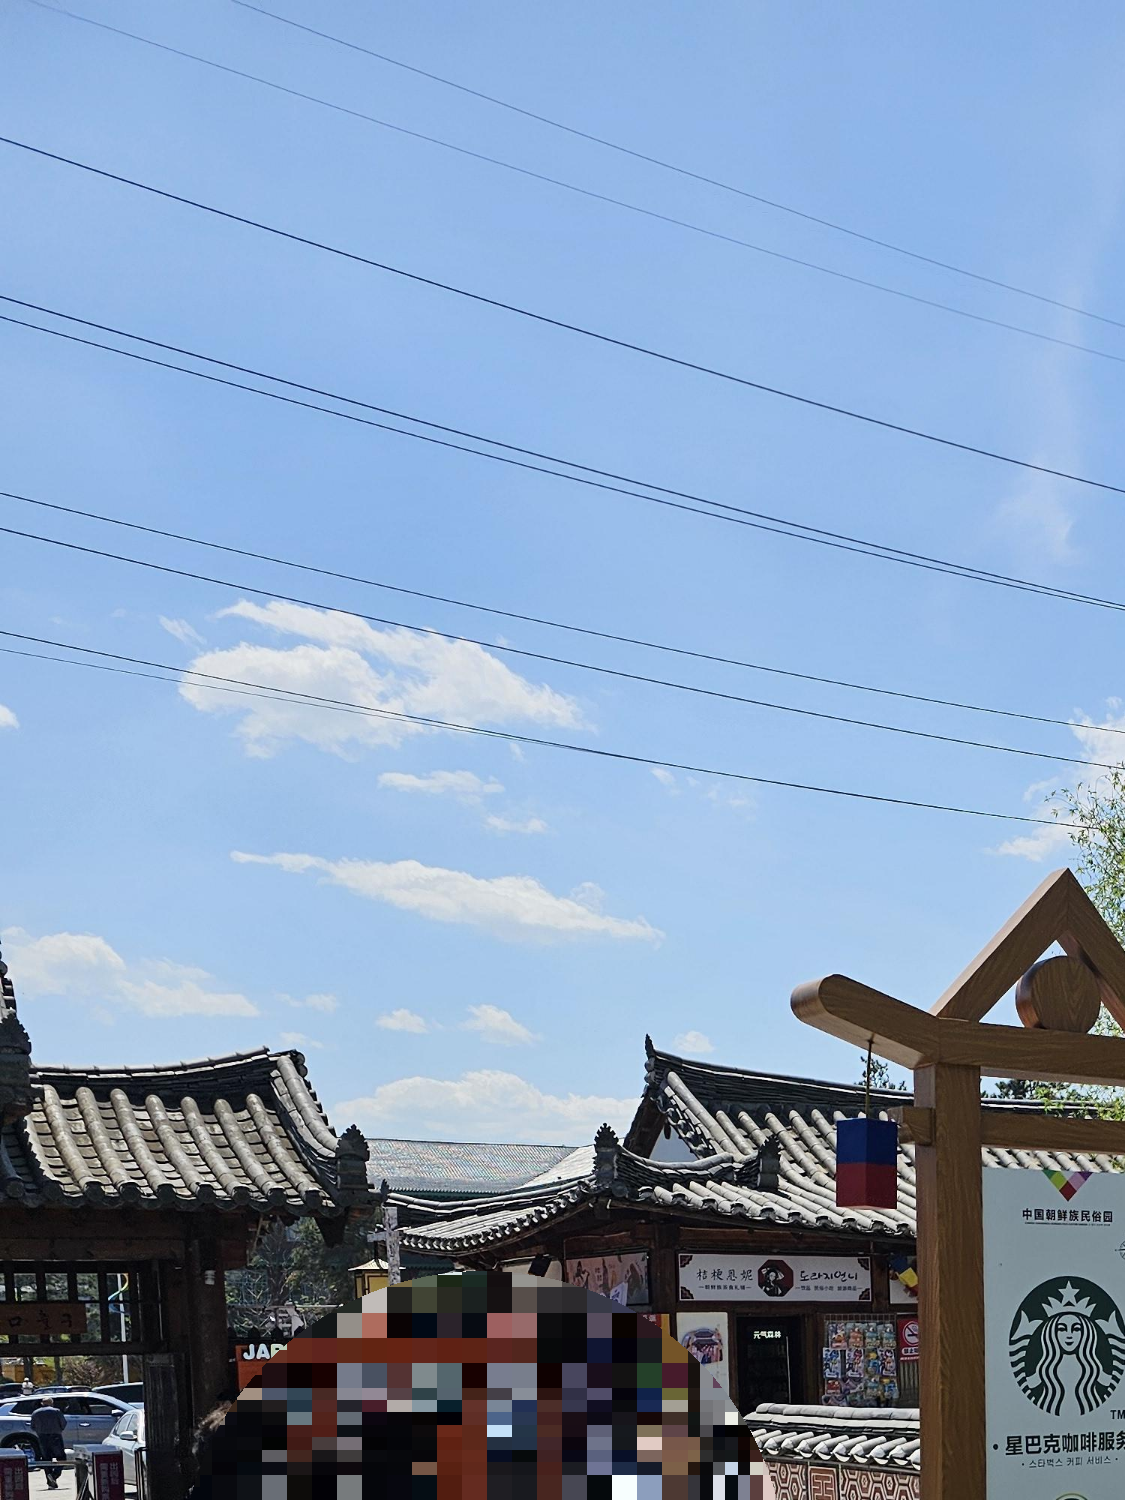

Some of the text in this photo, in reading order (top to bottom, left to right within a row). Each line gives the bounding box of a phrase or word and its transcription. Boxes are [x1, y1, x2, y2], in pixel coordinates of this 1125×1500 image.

[1022, 1208, 1113, 1223] 中国朝鲜族民俗园
[799, 1270, 858, 1282] 도라지언니
[753, 1330, 782, 1340] 元气森林
[1110, 1409, 1125, 1420] TM
[1029, 1456, 1112, 1469] 스타벅스 커피 서비스
